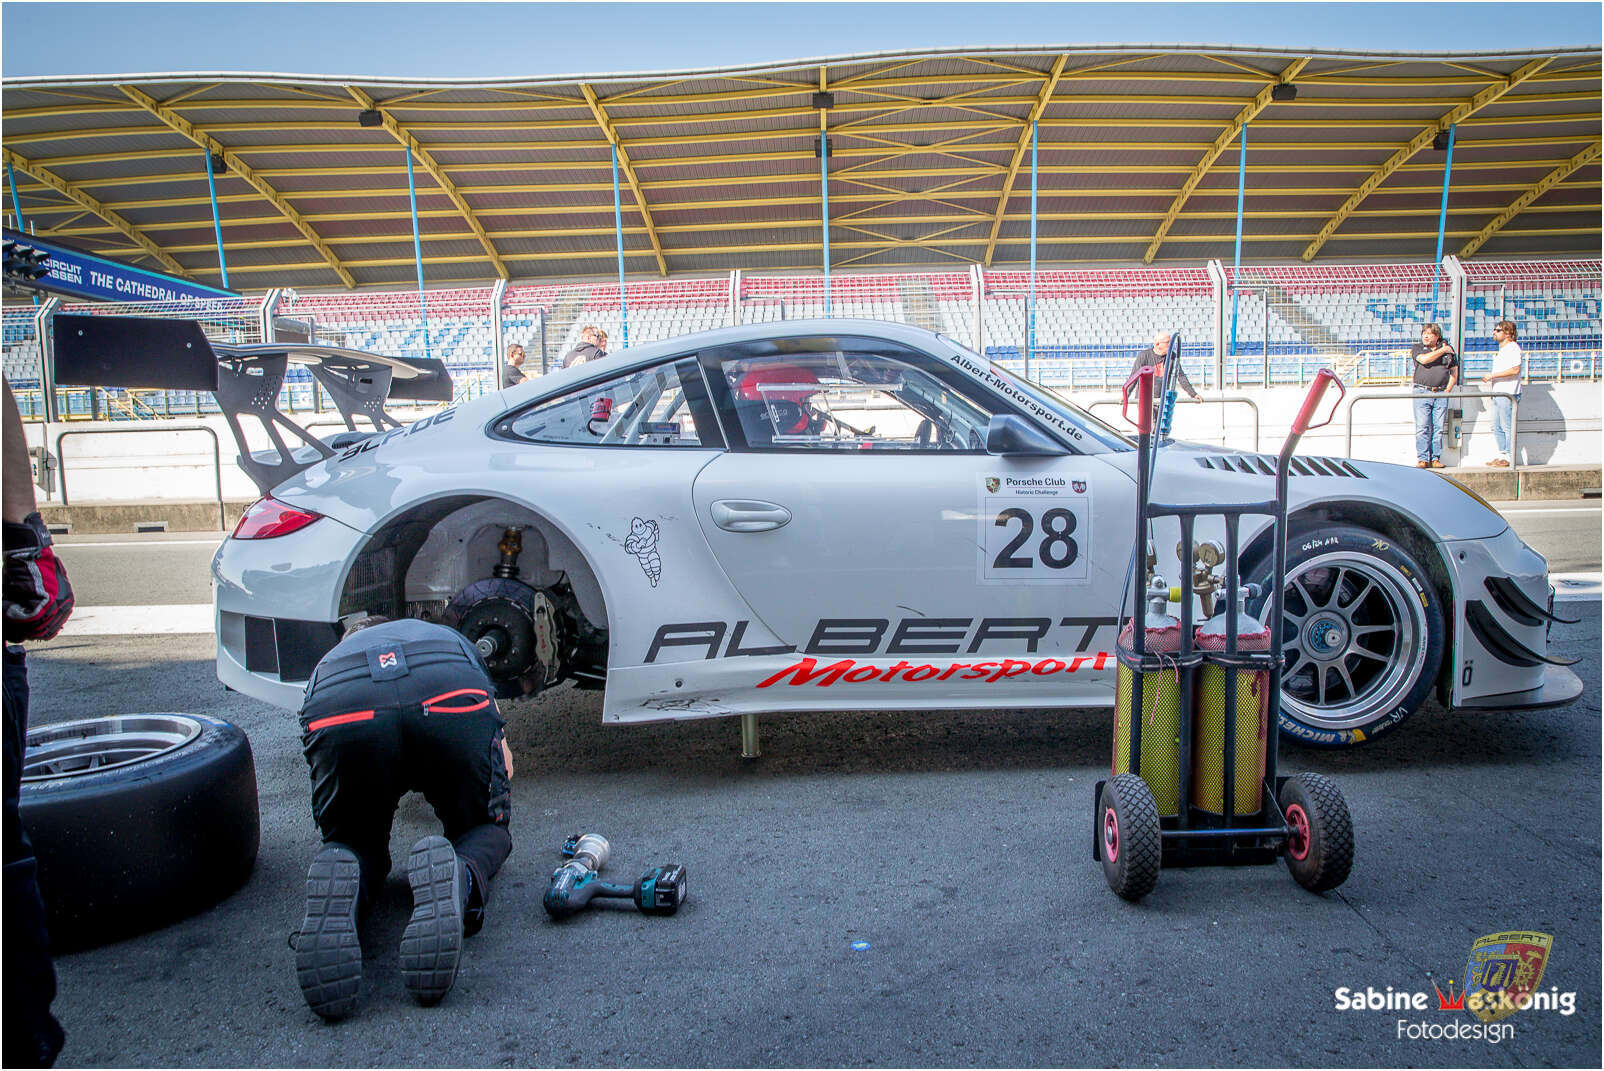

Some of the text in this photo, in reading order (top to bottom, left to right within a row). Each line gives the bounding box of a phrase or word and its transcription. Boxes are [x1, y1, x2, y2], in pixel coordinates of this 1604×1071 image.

[42, 258, 82, 275] CIRCUIT
[89, 271, 113, 289] THE
[115, 275, 177, 303] CATHEDRAL
[950, 353, 1083, 441] Albert-Motorsport.de
[1006, 477, 1066, 486] Porsche Club
[992, 507, 1079, 570] 28
[643, 616, 1132, 664] ALBERT
[755, 651, 1118, 689] Motorsport
[1462, 660, 1474, 686] Ö
